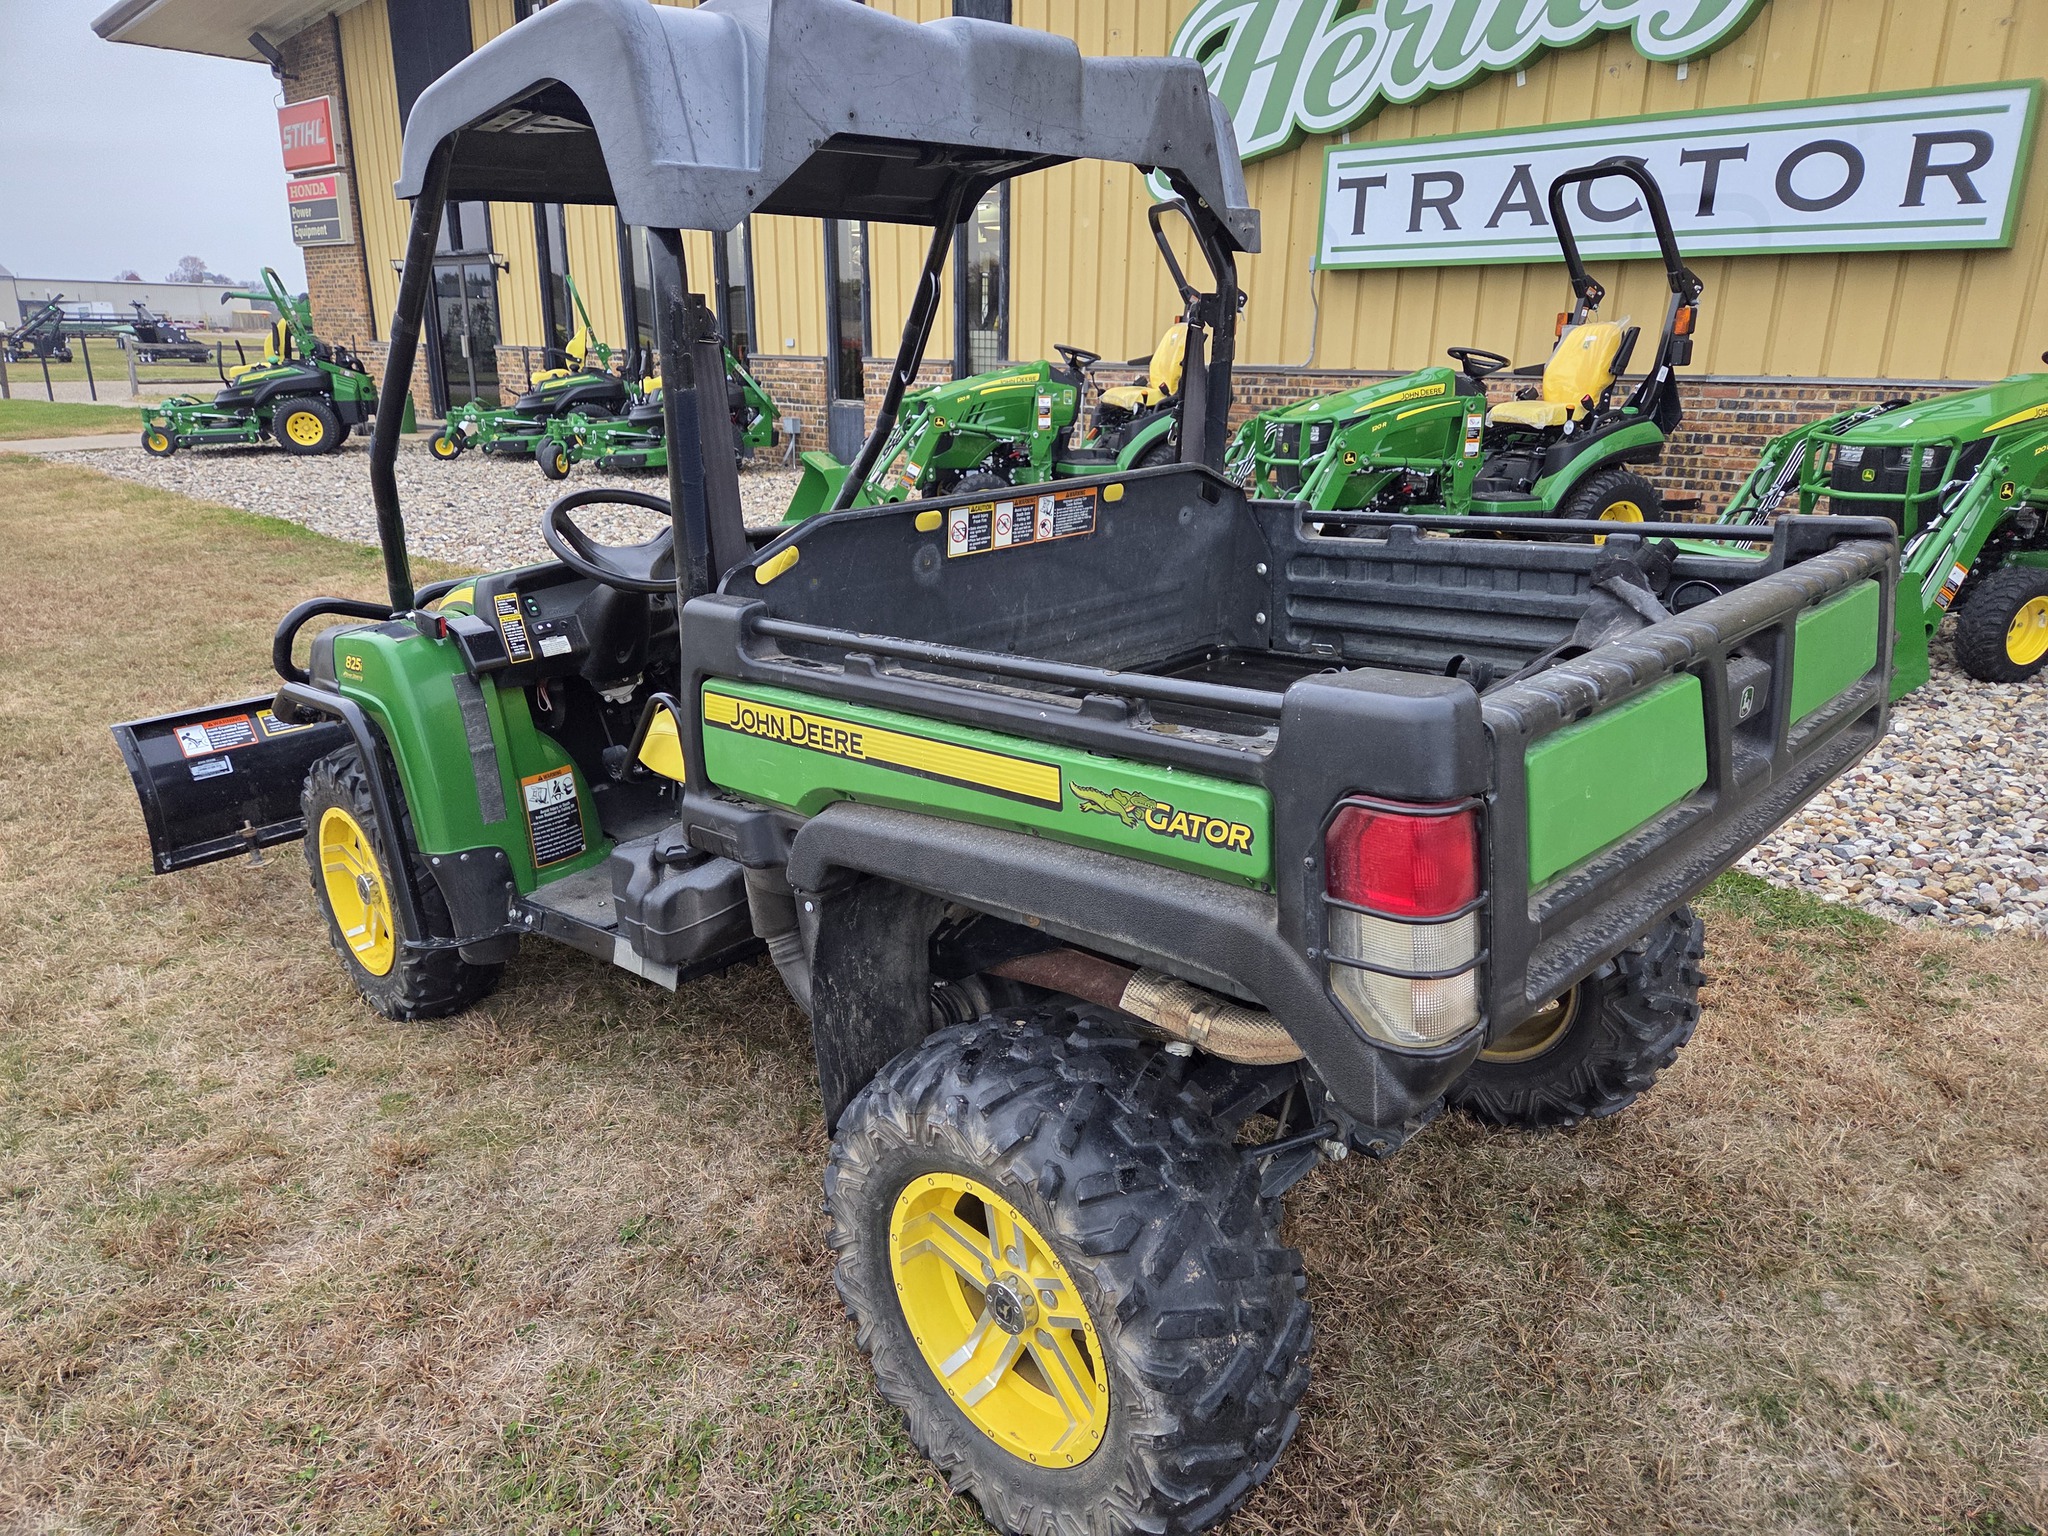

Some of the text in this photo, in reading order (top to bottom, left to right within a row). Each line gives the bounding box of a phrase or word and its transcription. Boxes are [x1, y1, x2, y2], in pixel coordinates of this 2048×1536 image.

[282, 120, 327, 151] STIHL
[289, 181, 328, 199] HONDA
[1337, 129, 1995, 235] TRACTOR
[291, 206, 312, 219] Power
[293, 224, 328, 239] Equipment
[1400, 387, 1442, 401] JOHN DEERE
[214, 716, 242, 726] WARNING
[730, 702, 864, 756] JOHN DEERE
[1144, 801, 1254, 853] GATOR
